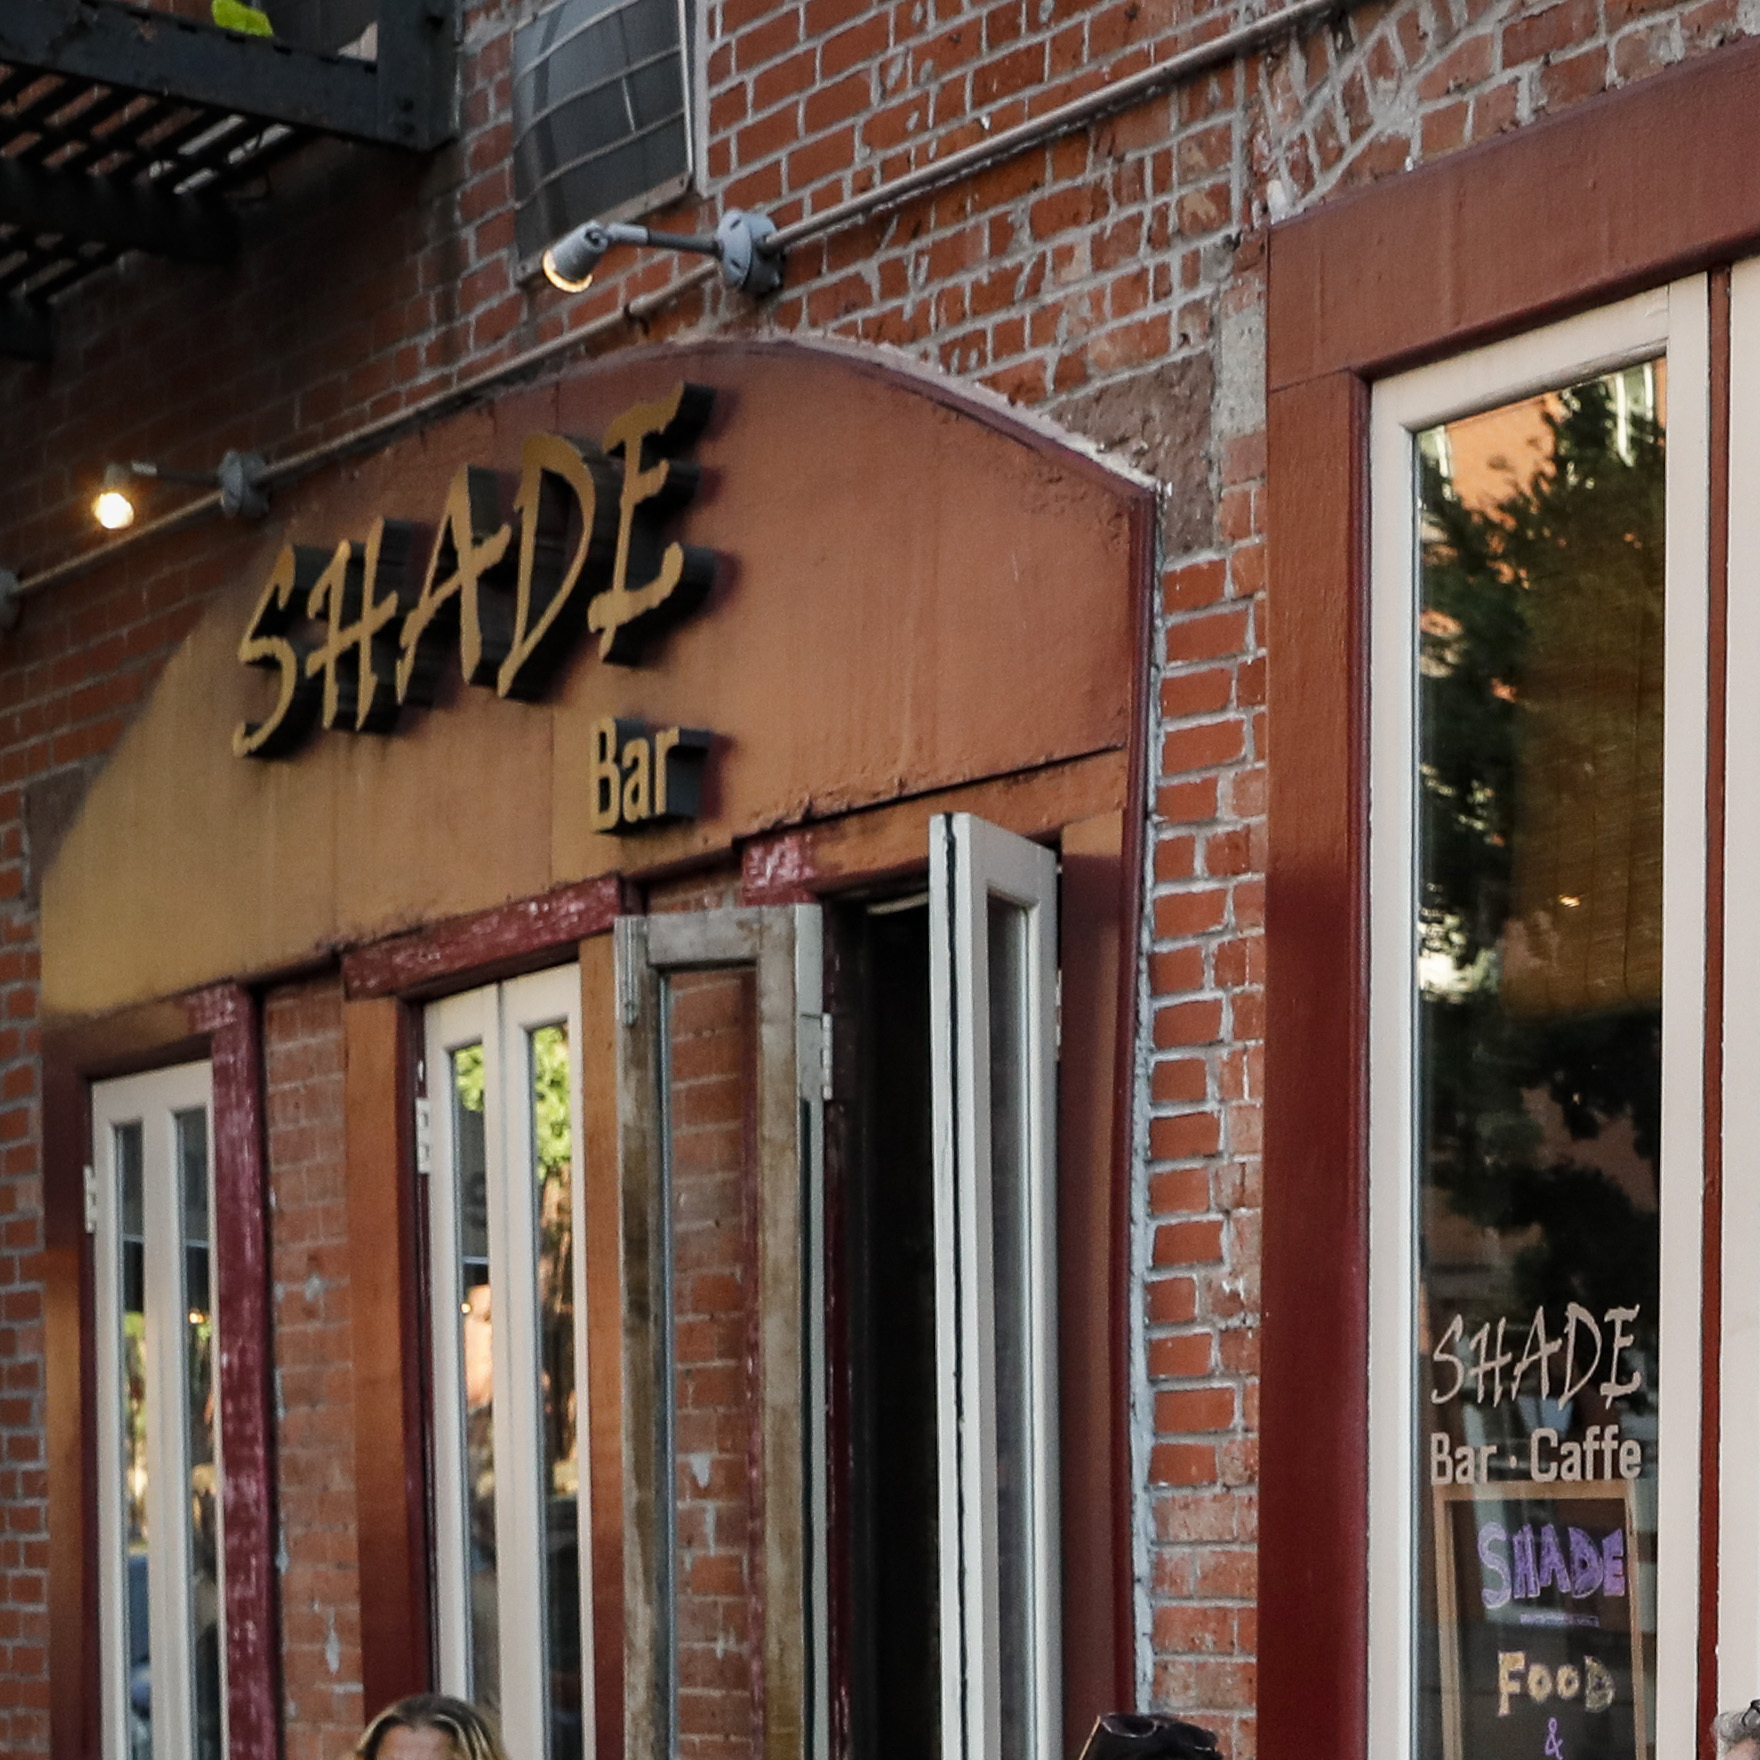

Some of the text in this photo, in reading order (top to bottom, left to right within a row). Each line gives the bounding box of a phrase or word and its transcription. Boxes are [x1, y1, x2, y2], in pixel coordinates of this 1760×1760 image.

[233, 380, 694, 760] SHADE
[592, 717, 684, 834] Bar
[1431, 1301, 1641, 1410] SHADE
[1430, 1424, 1642, 1486] Bar Caffe
[1477, 1521, 1626, 1610] SHADE
[1544, 1717, 1564, 1760] &
